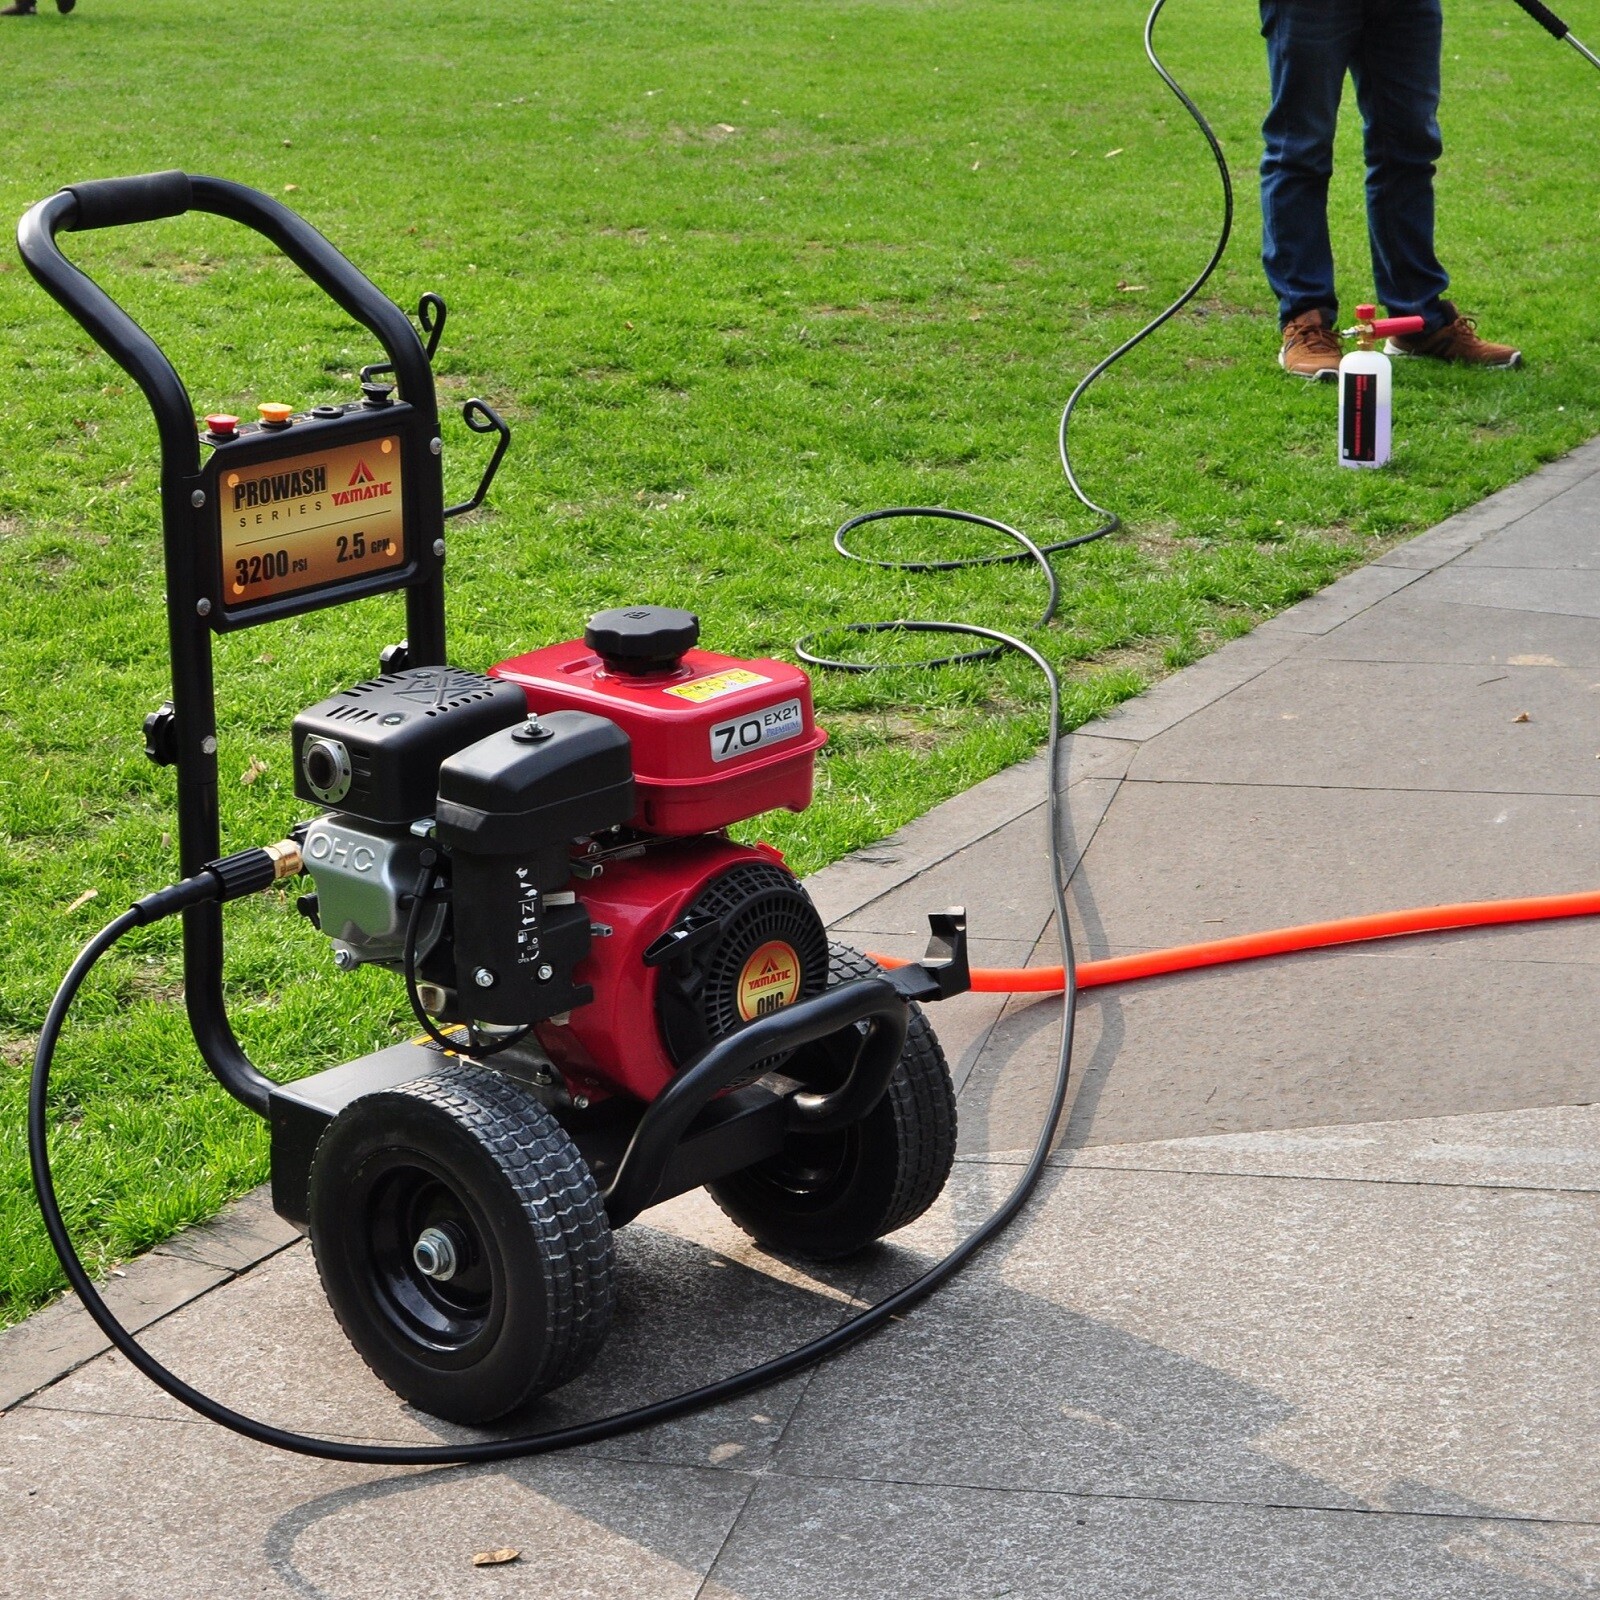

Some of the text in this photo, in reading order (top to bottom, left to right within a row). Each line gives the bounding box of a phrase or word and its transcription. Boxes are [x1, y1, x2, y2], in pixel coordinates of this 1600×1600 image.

[234, 465, 327, 511] PROWASH
[331, 481, 392, 506] YAMATIC
[239, 501, 322, 527] SERIES
[336, 532, 390, 563] 2.5 GPM
[235, 549, 308, 586] 3200 PSI
[764, 705, 799, 726] EX21
[715, 720, 762, 754] 7.0
[308, 832, 375, 872] OHC
[748, 969, 791, 990] YAMATIC
